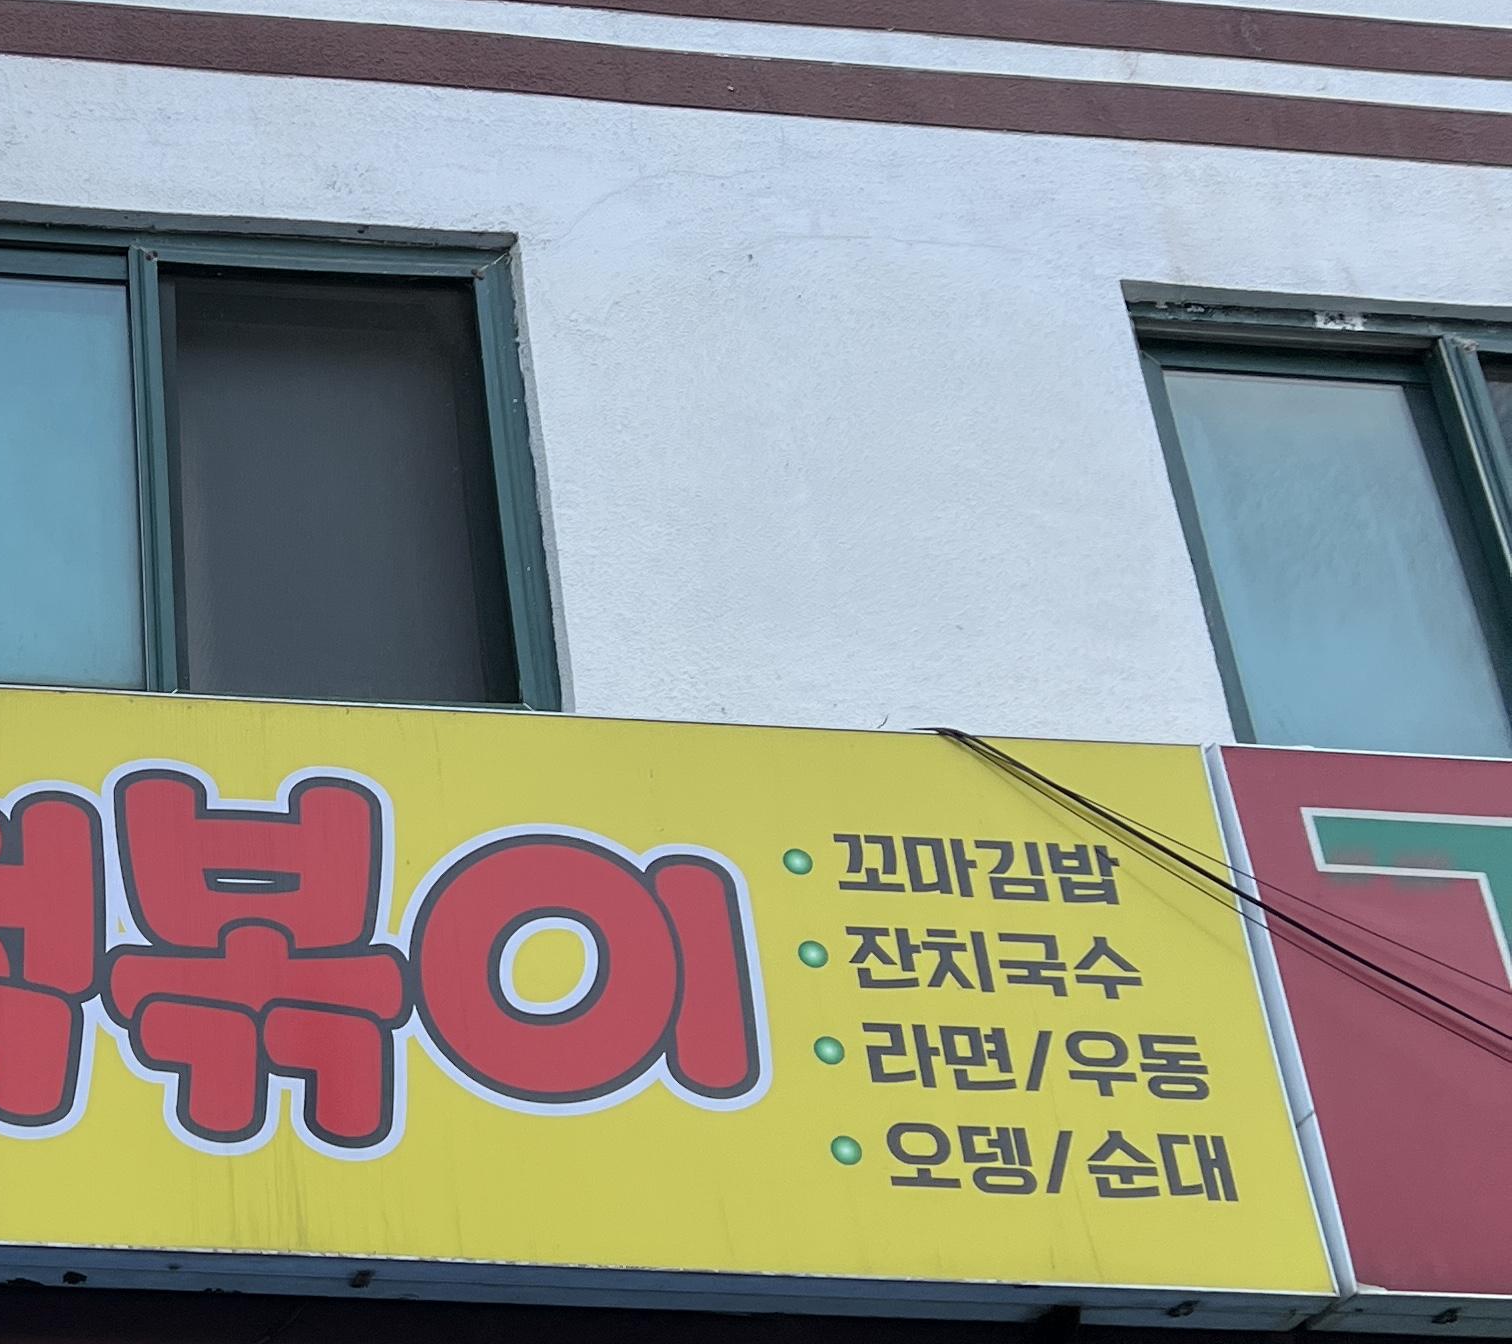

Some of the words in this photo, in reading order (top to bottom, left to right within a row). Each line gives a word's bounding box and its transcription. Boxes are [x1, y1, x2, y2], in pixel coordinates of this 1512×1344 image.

[832, 832, 1120, 906] 꼬마김밥
[844, 925, 1142, 1000] 잔치국수
[861, 1021, 1210, 1101] 라면/우동
[886, 1121, 1240, 1202] 오뎅/순대
